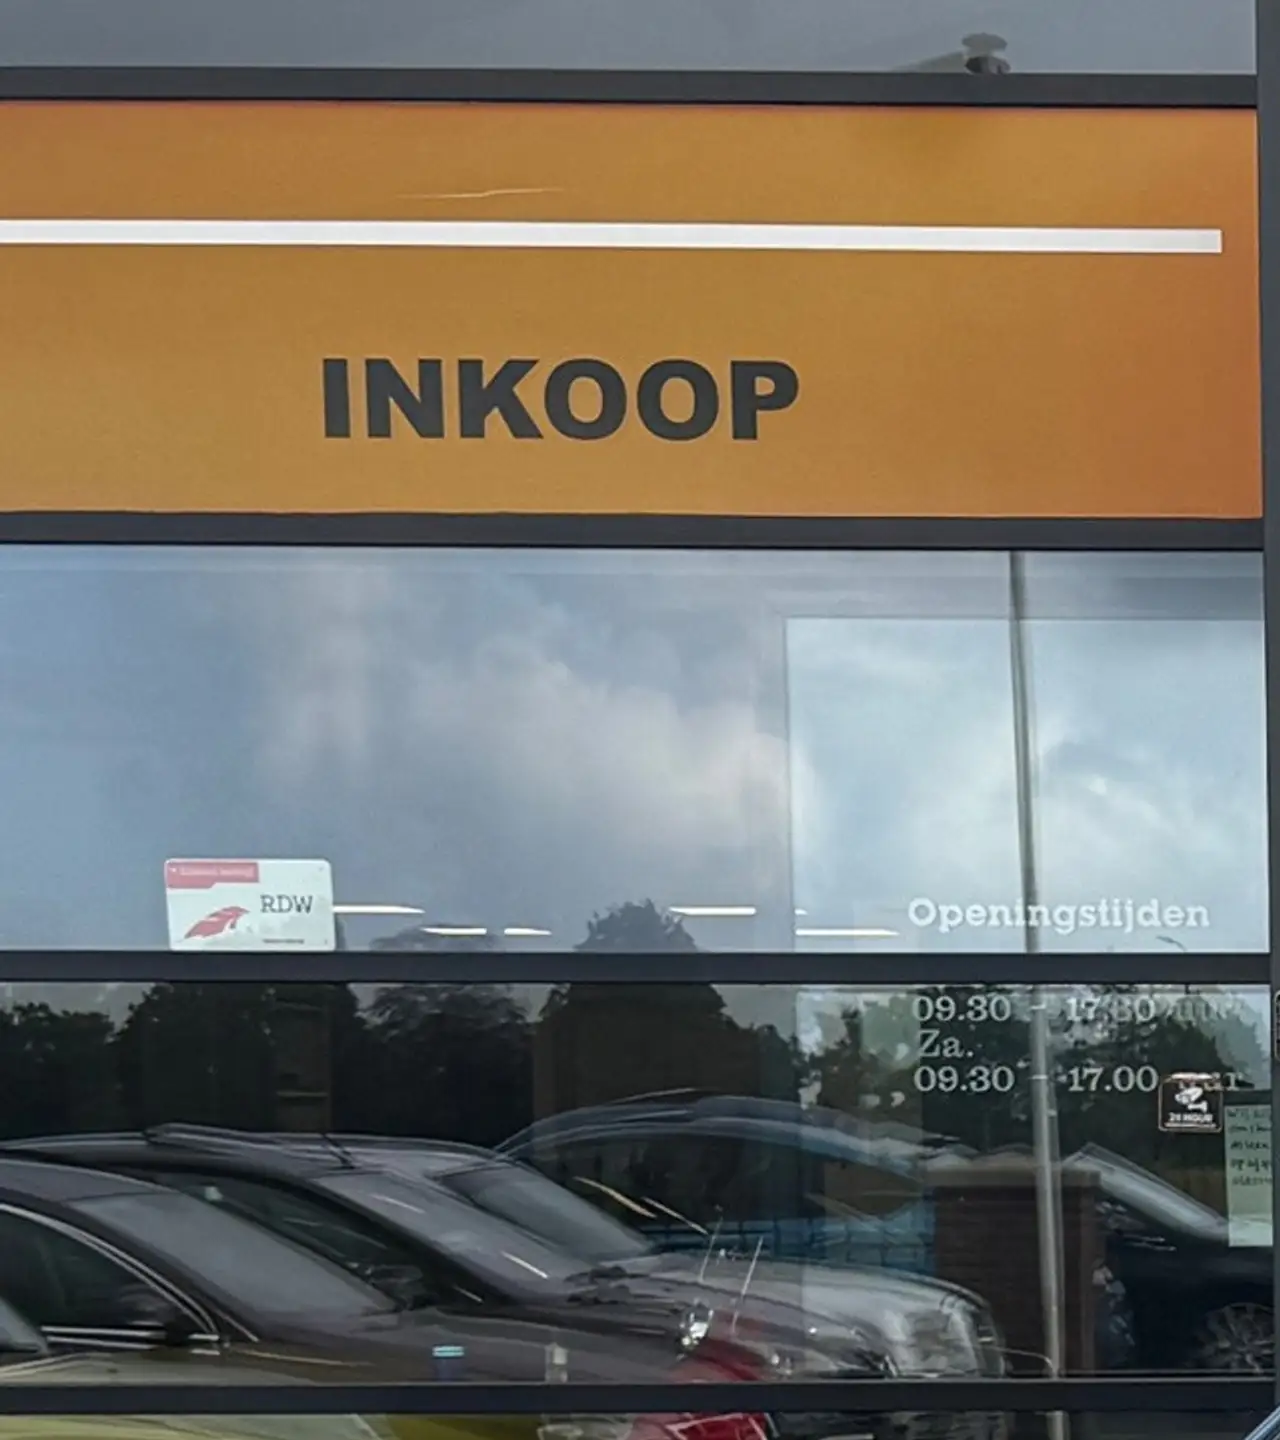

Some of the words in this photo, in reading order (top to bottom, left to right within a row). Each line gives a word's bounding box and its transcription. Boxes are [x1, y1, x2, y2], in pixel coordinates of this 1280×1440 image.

[322, 357, 800, 442] INKOOP
[260, 894, 313, 914] RDW
[907, 897, 1210, 935] Openingstijden
[912, 995, 1011, 1022] 09.30
[918, 1029, 975, 1058] Za.
[913, 1066, 1015, 1092] 09.30
[1066, 1066, 1159, 1092] 17.00
